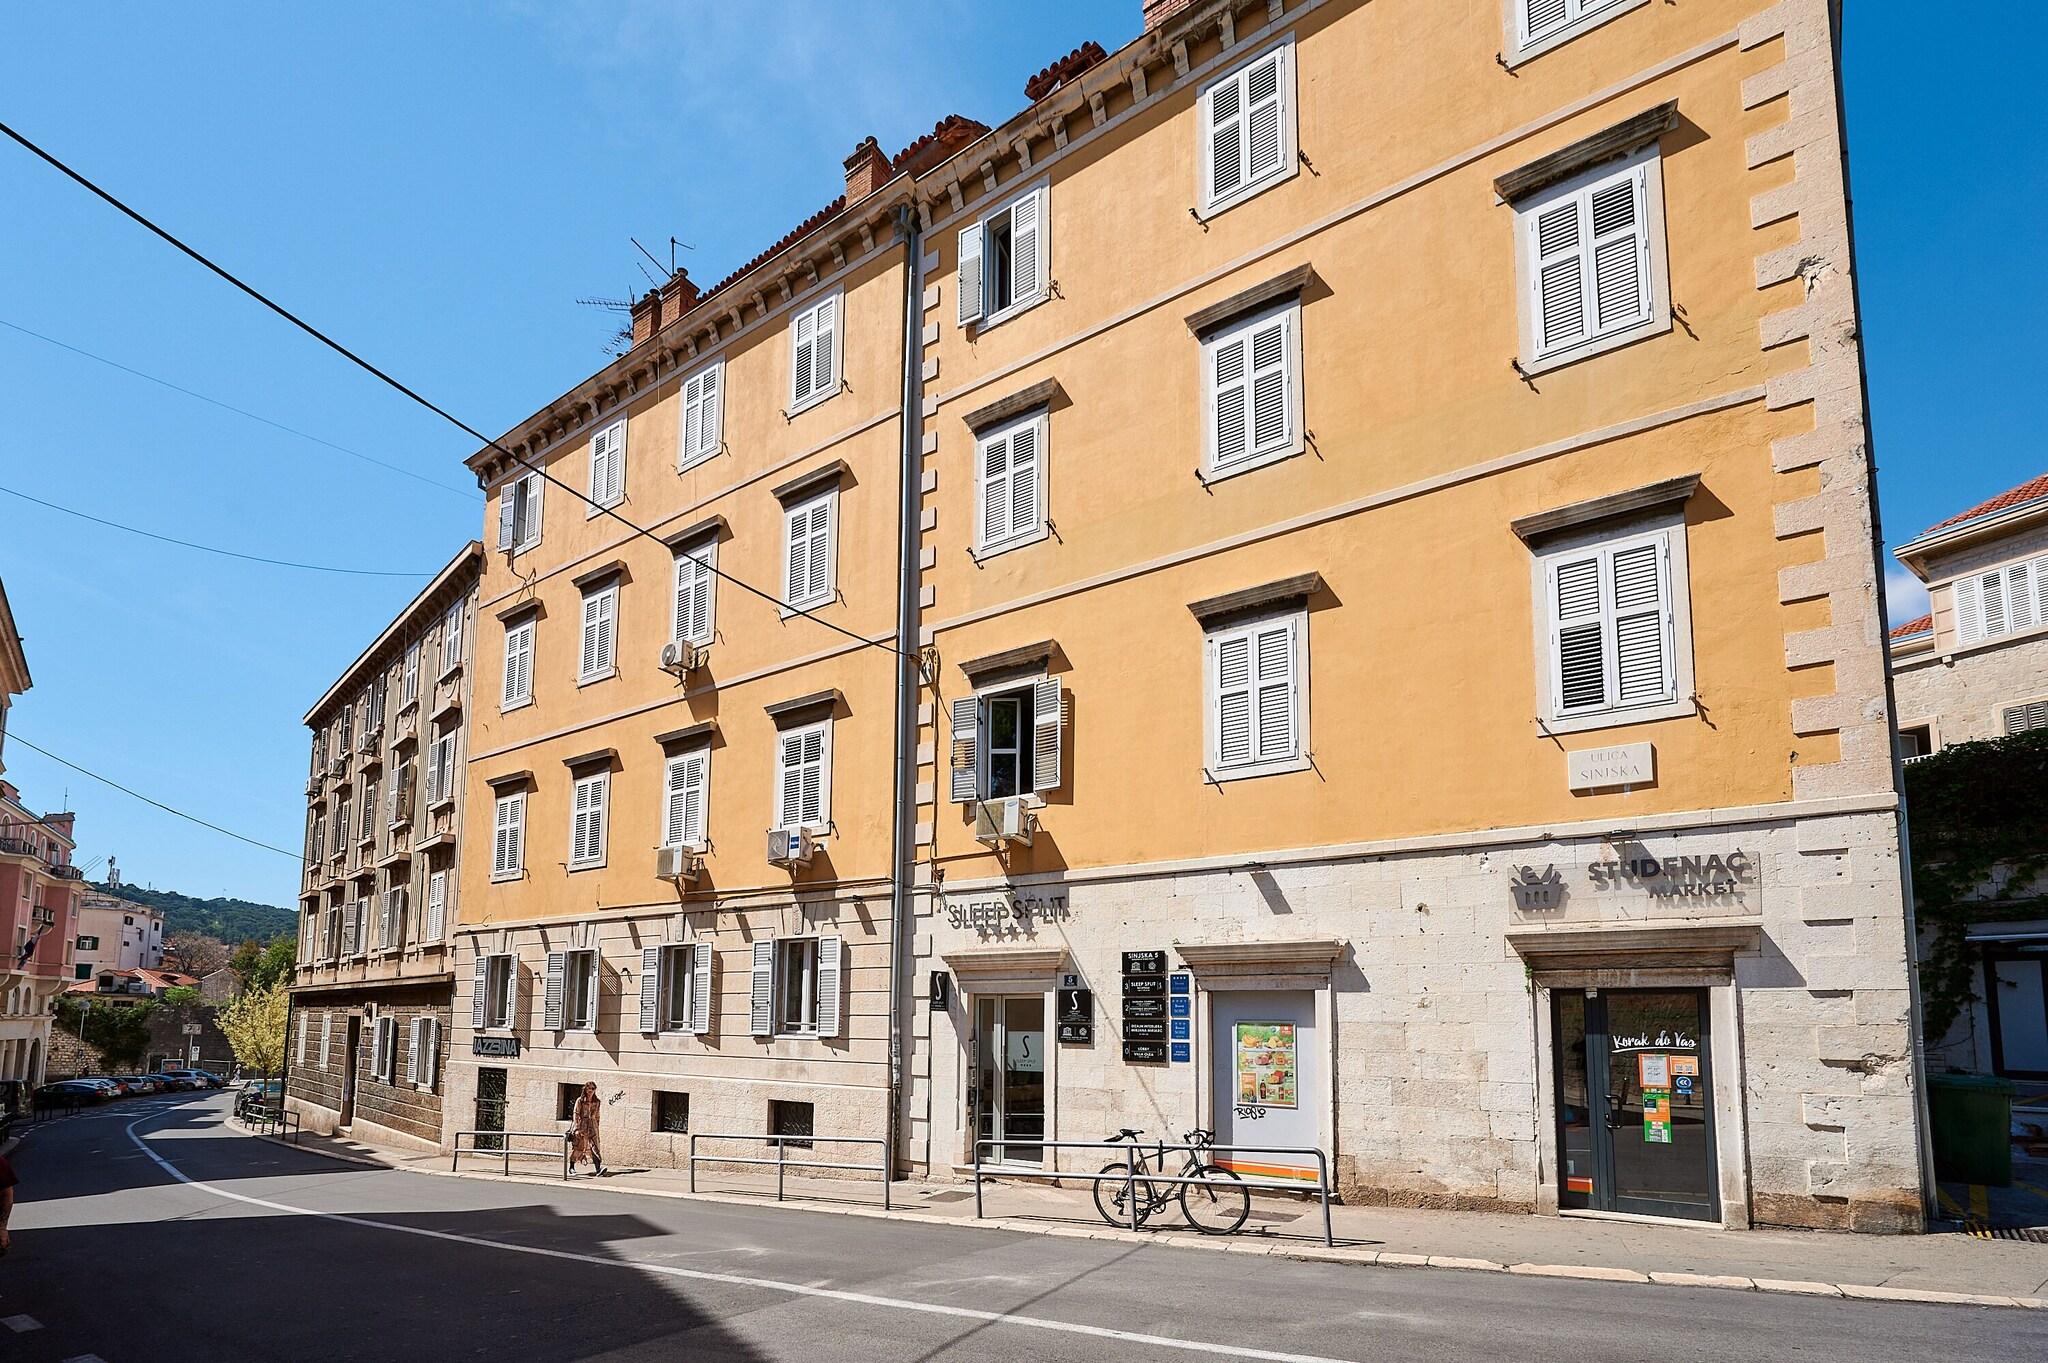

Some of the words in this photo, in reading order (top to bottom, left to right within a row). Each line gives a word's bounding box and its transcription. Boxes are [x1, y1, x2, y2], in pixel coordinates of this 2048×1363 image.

[1590, 751, 1628, 762] ULICA
[1588, 852, 1748, 881] STUDENAC
[1649, 879, 1738, 898] MARKET
[947, 901, 1009, 923] SLEEP
[1012, 896, 1066, 920] SPLIT
[1124, 982, 1129, 990] 3
[1124, 1004, 1129, 1012] 2
[1612, 1032, 1650, 1049] Korak
[1655, 1030, 1671, 1047] do
[1674, 1031, 1697, 1048] Vas
